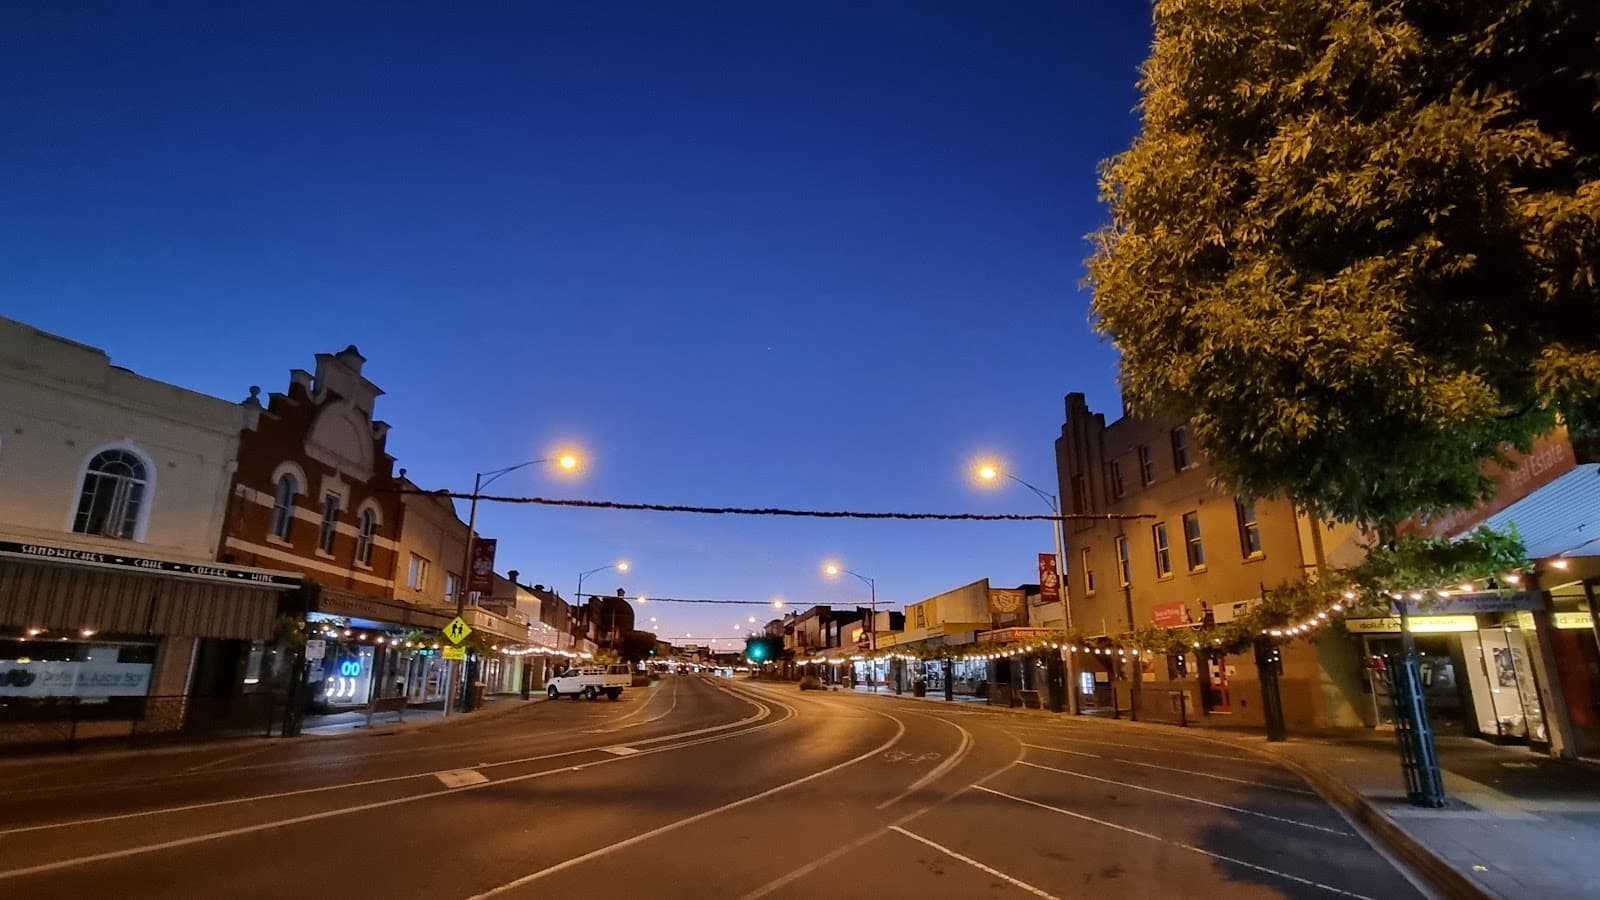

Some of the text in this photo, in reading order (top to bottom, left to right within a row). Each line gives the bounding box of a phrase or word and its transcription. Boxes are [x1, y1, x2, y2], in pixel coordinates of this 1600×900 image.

[1529, 444, 1564, 476] Estate
[21, 543, 105, 562] SANDWICHES
[190, 565, 229, 578] COFFEE
[251, 573, 274, 584] WINE
